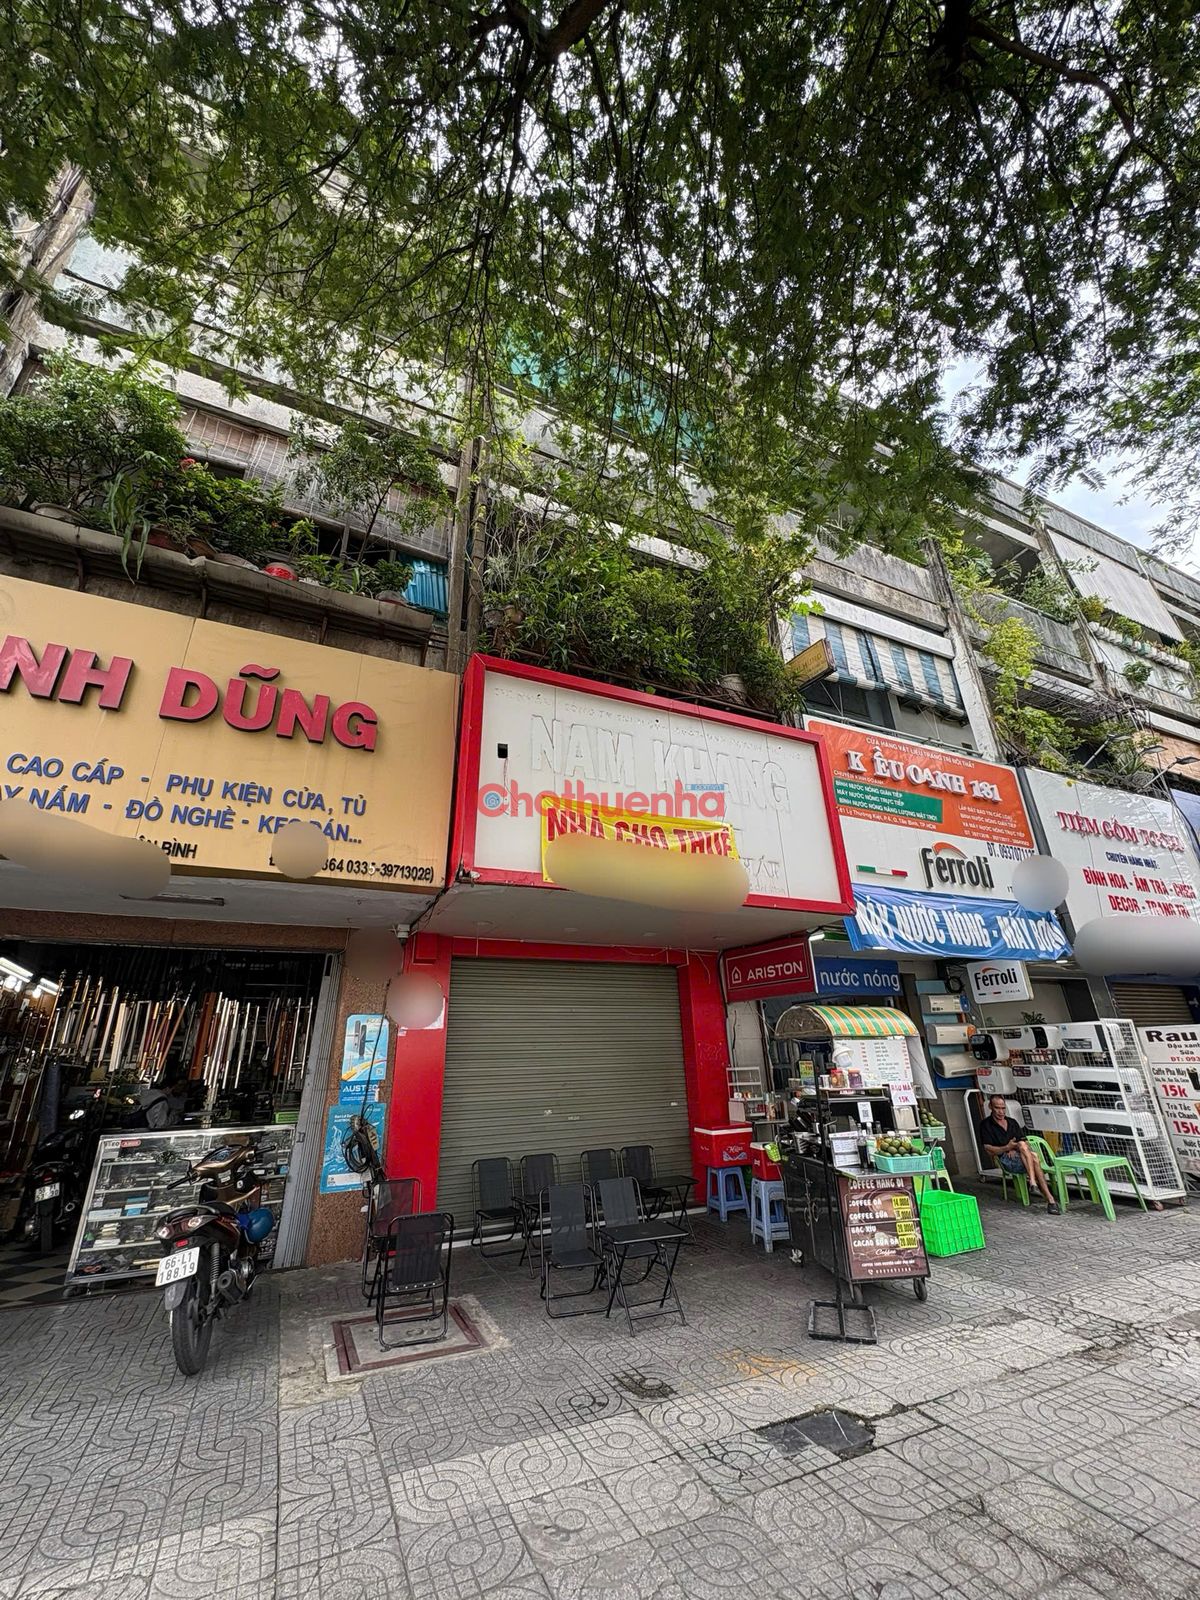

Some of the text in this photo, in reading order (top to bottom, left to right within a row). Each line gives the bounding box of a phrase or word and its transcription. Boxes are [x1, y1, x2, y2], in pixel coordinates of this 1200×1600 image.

[159, 664, 379, 751] DŨNG
[6, 753, 63, 779] CAO
[71, 761, 124, 789] CẤP
[166, 775, 212, 801] PHỤ
[222, 780, 273, 808] KIỆN
[283, 786, 333, 814] CỬA,
[341, 794, 366, 817] TỦ
[906, 764, 969, 796] OANH
[970, 779, 1002, 804] 181
[29, 784, 91, 814] NẮM
[126, 796, 163, 821] ĐỒ
[171, 806, 236, 830] NGHỀ
[1057, 810, 1101, 839] TIỆM
[1102, 815, 1139, 846] GỐM
[162, 837, 198, 859] BÌNH
[1105, 852, 1128, 864] CHUYÊN
[920, 846, 995, 891] Ferroli
[1082, 867, 1108, 887] BÌNH
[1109, 872, 1129, 891] HOA
[1107, 894, 1142, 914] DECOR
[893, 901, 946, 943] NƯỚC
[942, 905, 992, 948] NÓNG
[747, 961, 804, 981] ARISTON
[820, 966, 901, 992] nước nóng
[974, 968, 1018, 991] Ferroli
[1145, 1030, 1198, 1043] Rau
[1161, 1084, 1188, 1098] 15k
[1165, 1109, 1198, 1120] Trà Chanh
[1166, 1102, 1178, 1111] Trà
[1173, 1120, 1200, 1135] 15k
[849, 1212, 875, 1220] COFFEE
[165, 1252, 193, 1270] 66-L1
[160, 1263, 194, 1283] 188.19
